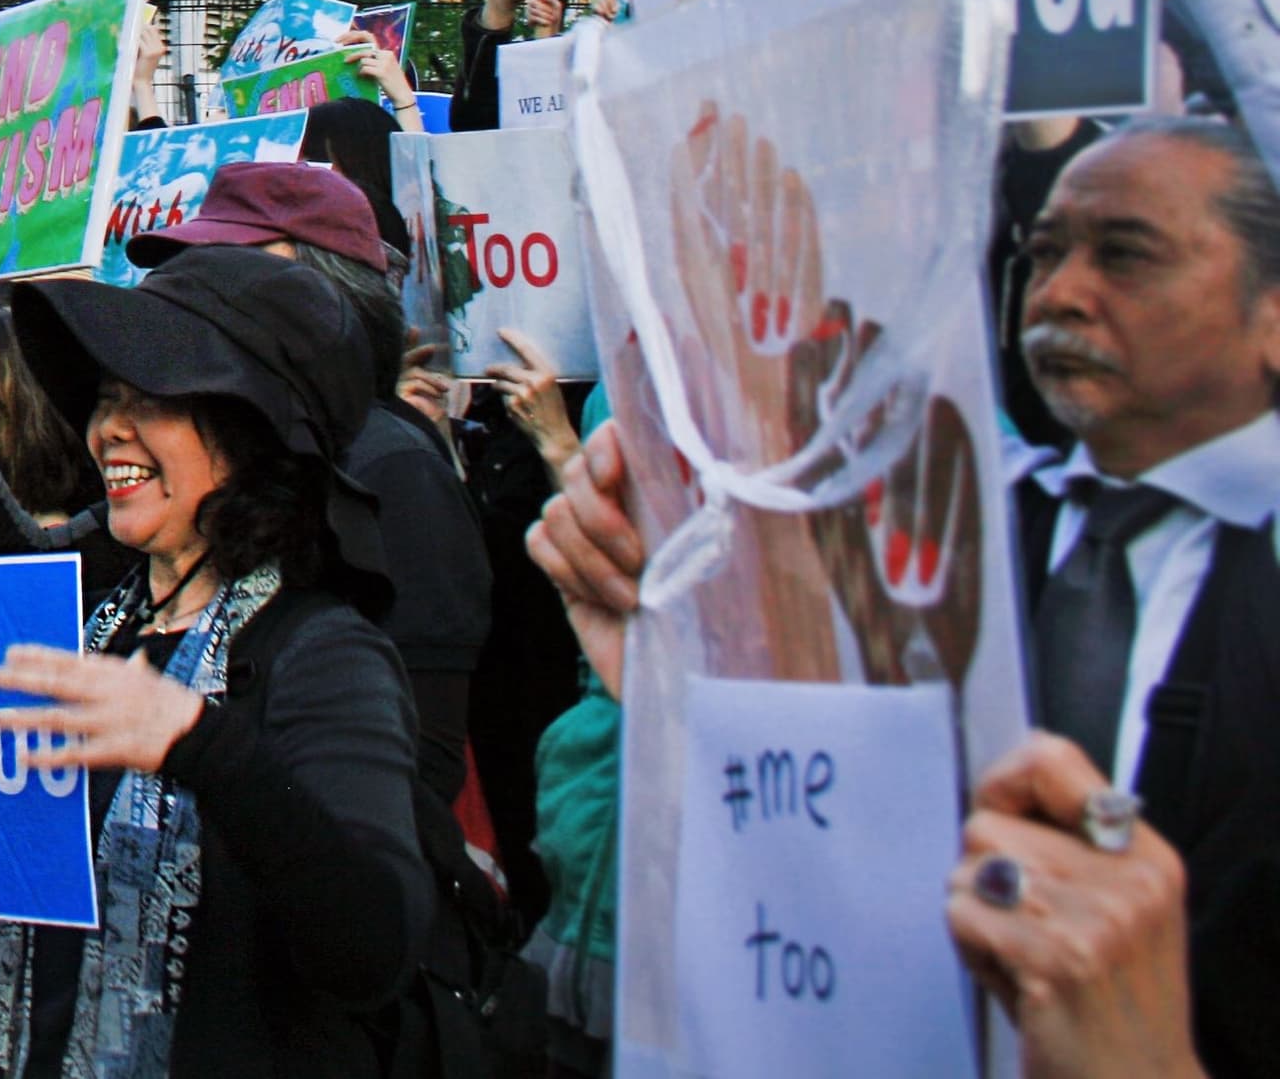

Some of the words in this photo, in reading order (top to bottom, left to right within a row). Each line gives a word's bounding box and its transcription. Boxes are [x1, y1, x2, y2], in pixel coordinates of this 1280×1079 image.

[518, 96, 542, 115] WE
[448, 213, 559, 288] Too
[722, 747, 835, 831] #me
[744, 902, 836, 1004] too
